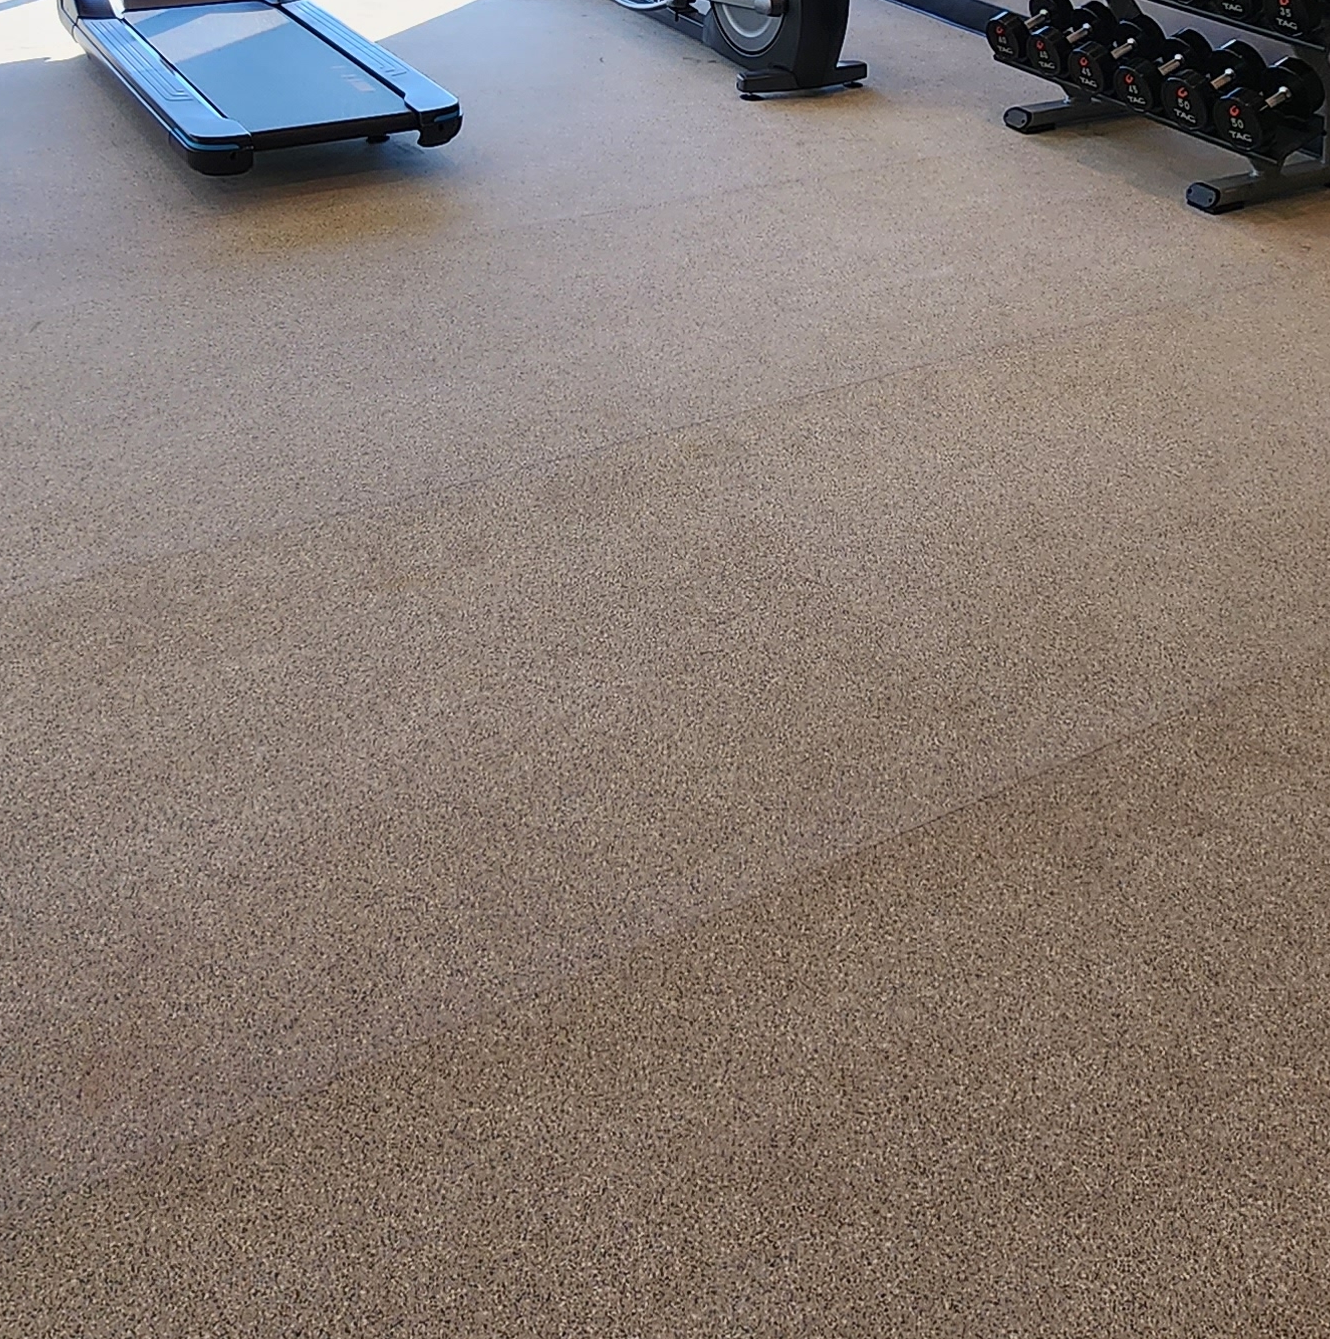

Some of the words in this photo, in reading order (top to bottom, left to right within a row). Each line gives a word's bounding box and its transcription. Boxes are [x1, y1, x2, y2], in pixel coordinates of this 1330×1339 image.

[1221, 2, 1243, 13] TAG
[1275, 17, 1298, 30] TAG
[996, 45, 1014, 55] TAG
[1038, 61, 1056, 69] TAG
[1079, 76, 1098, 88] TAG
[1126, 95, 1146, 105] TAG
[1173, 108, 1197, 124] TAG
[1228, 130, 1253, 143] TAG
